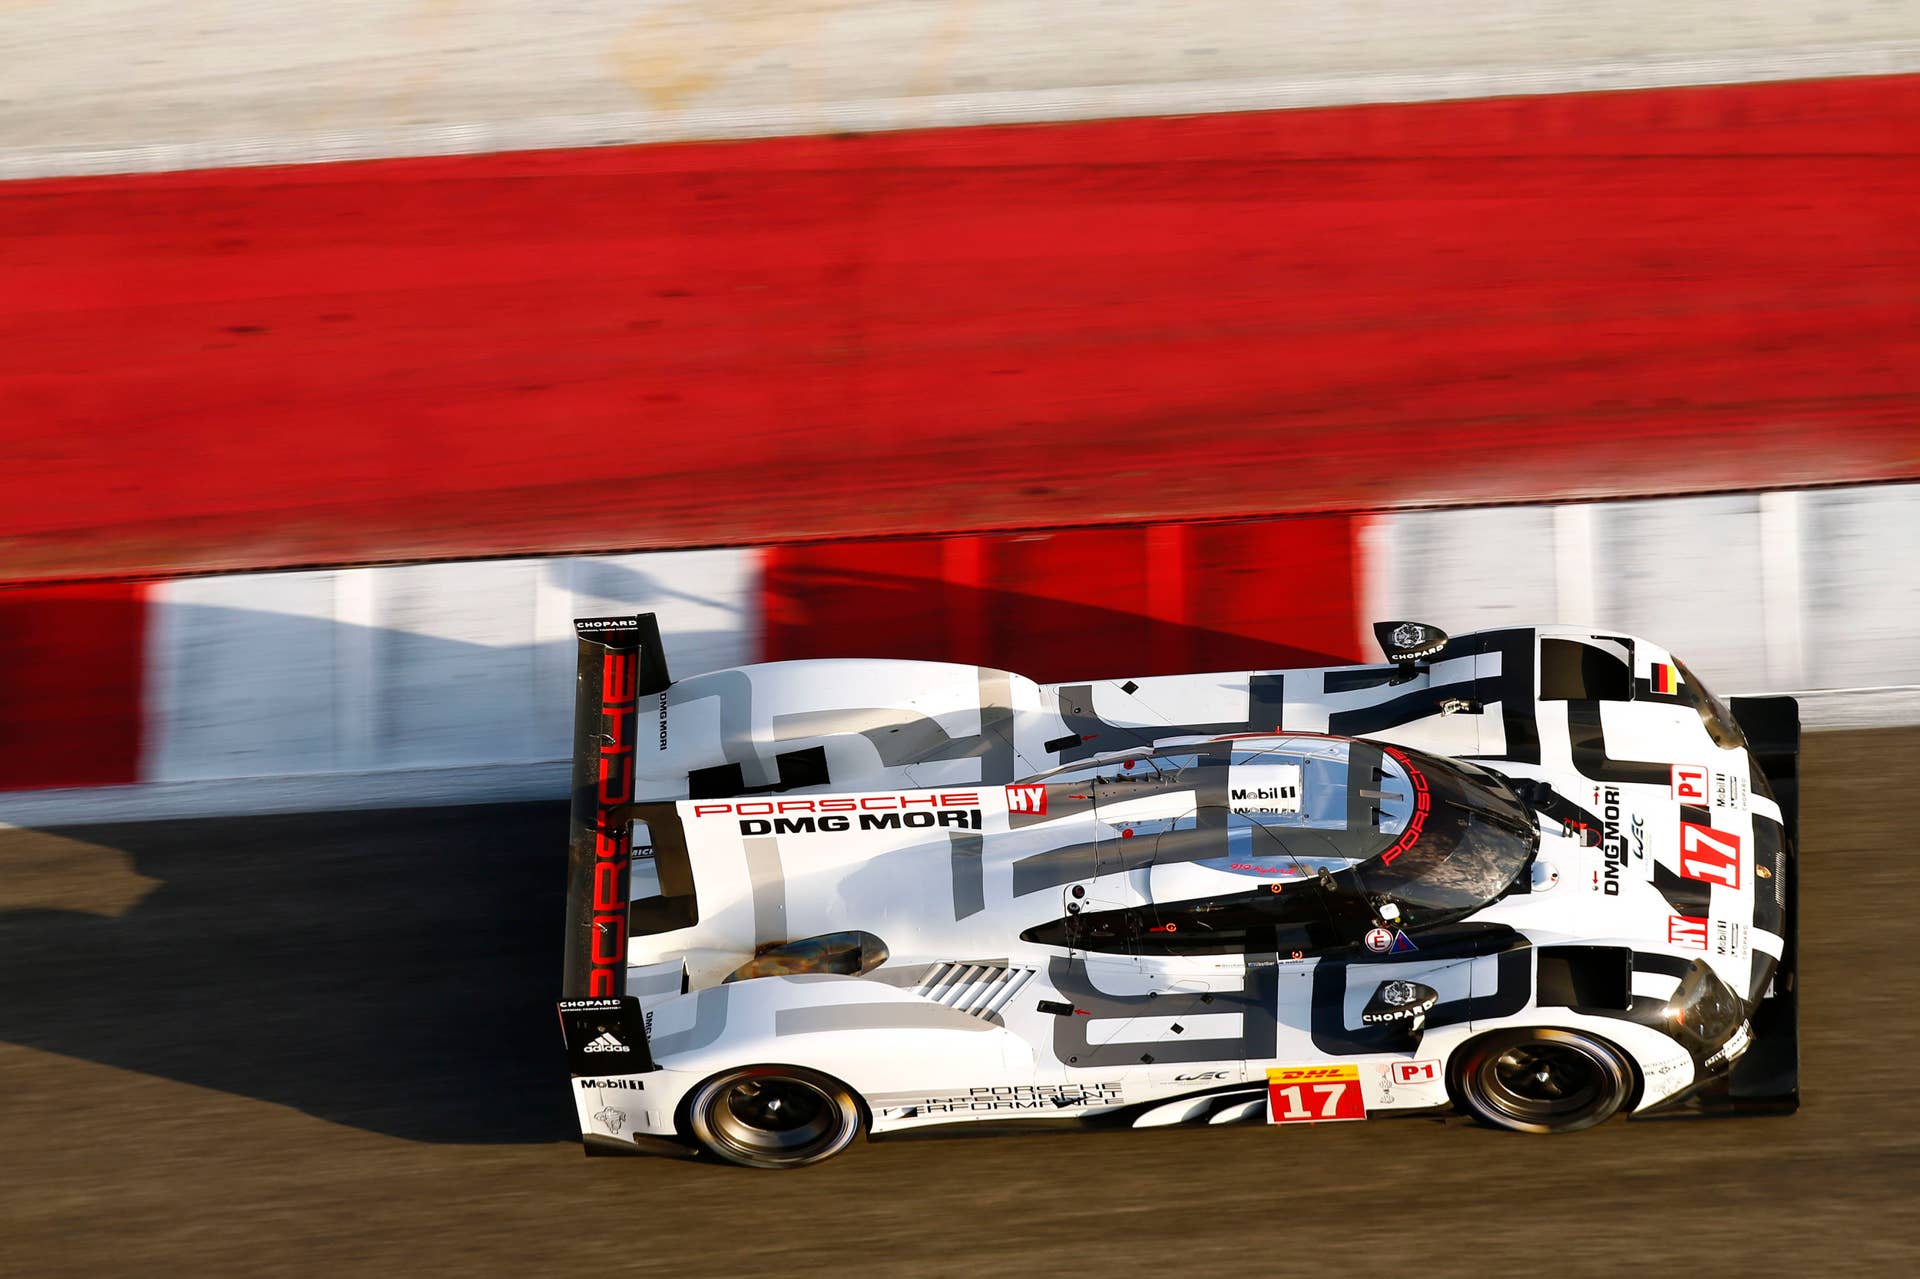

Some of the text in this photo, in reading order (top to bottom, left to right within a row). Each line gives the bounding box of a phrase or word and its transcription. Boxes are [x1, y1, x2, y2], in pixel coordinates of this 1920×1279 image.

[577, 620, 637, 628] CHOPARD
[1391, 644, 1444, 660] CHOPARD
[1231, 787, 1278, 800] Mobil
[1678, 772, 1702, 797] P1
[694, 793, 979, 817] PORSCHE
[1010, 787, 1044, 813] HY
[1381, 746, 1431, 867] PORSCHE
[739, 809, 983, 836] DMG MORI
[1604, 786, 1619, 896] DMG MORI
[1632, 813, 1643, 860] WEC
[1684, 825, 1736, 887] 17
[1670, 917, 1706, 950] HY
[560, 999, 621, 1008] CHOPARD
[1362, 1000, 1432, 1022] CHOPARD
[584, 1044, 630, 1053] adidas
[1174, 1071, 1230, 1081] WEC
[1282, 1069, 1344, 1079] DHL
[1401, 1064, 1433, 1080] P1
[581, 1079, 627, 1089] Mobil
[970, 1083, 1121, 1097] PORSCHE
[1280, 1083, 1347, 1118] 17
